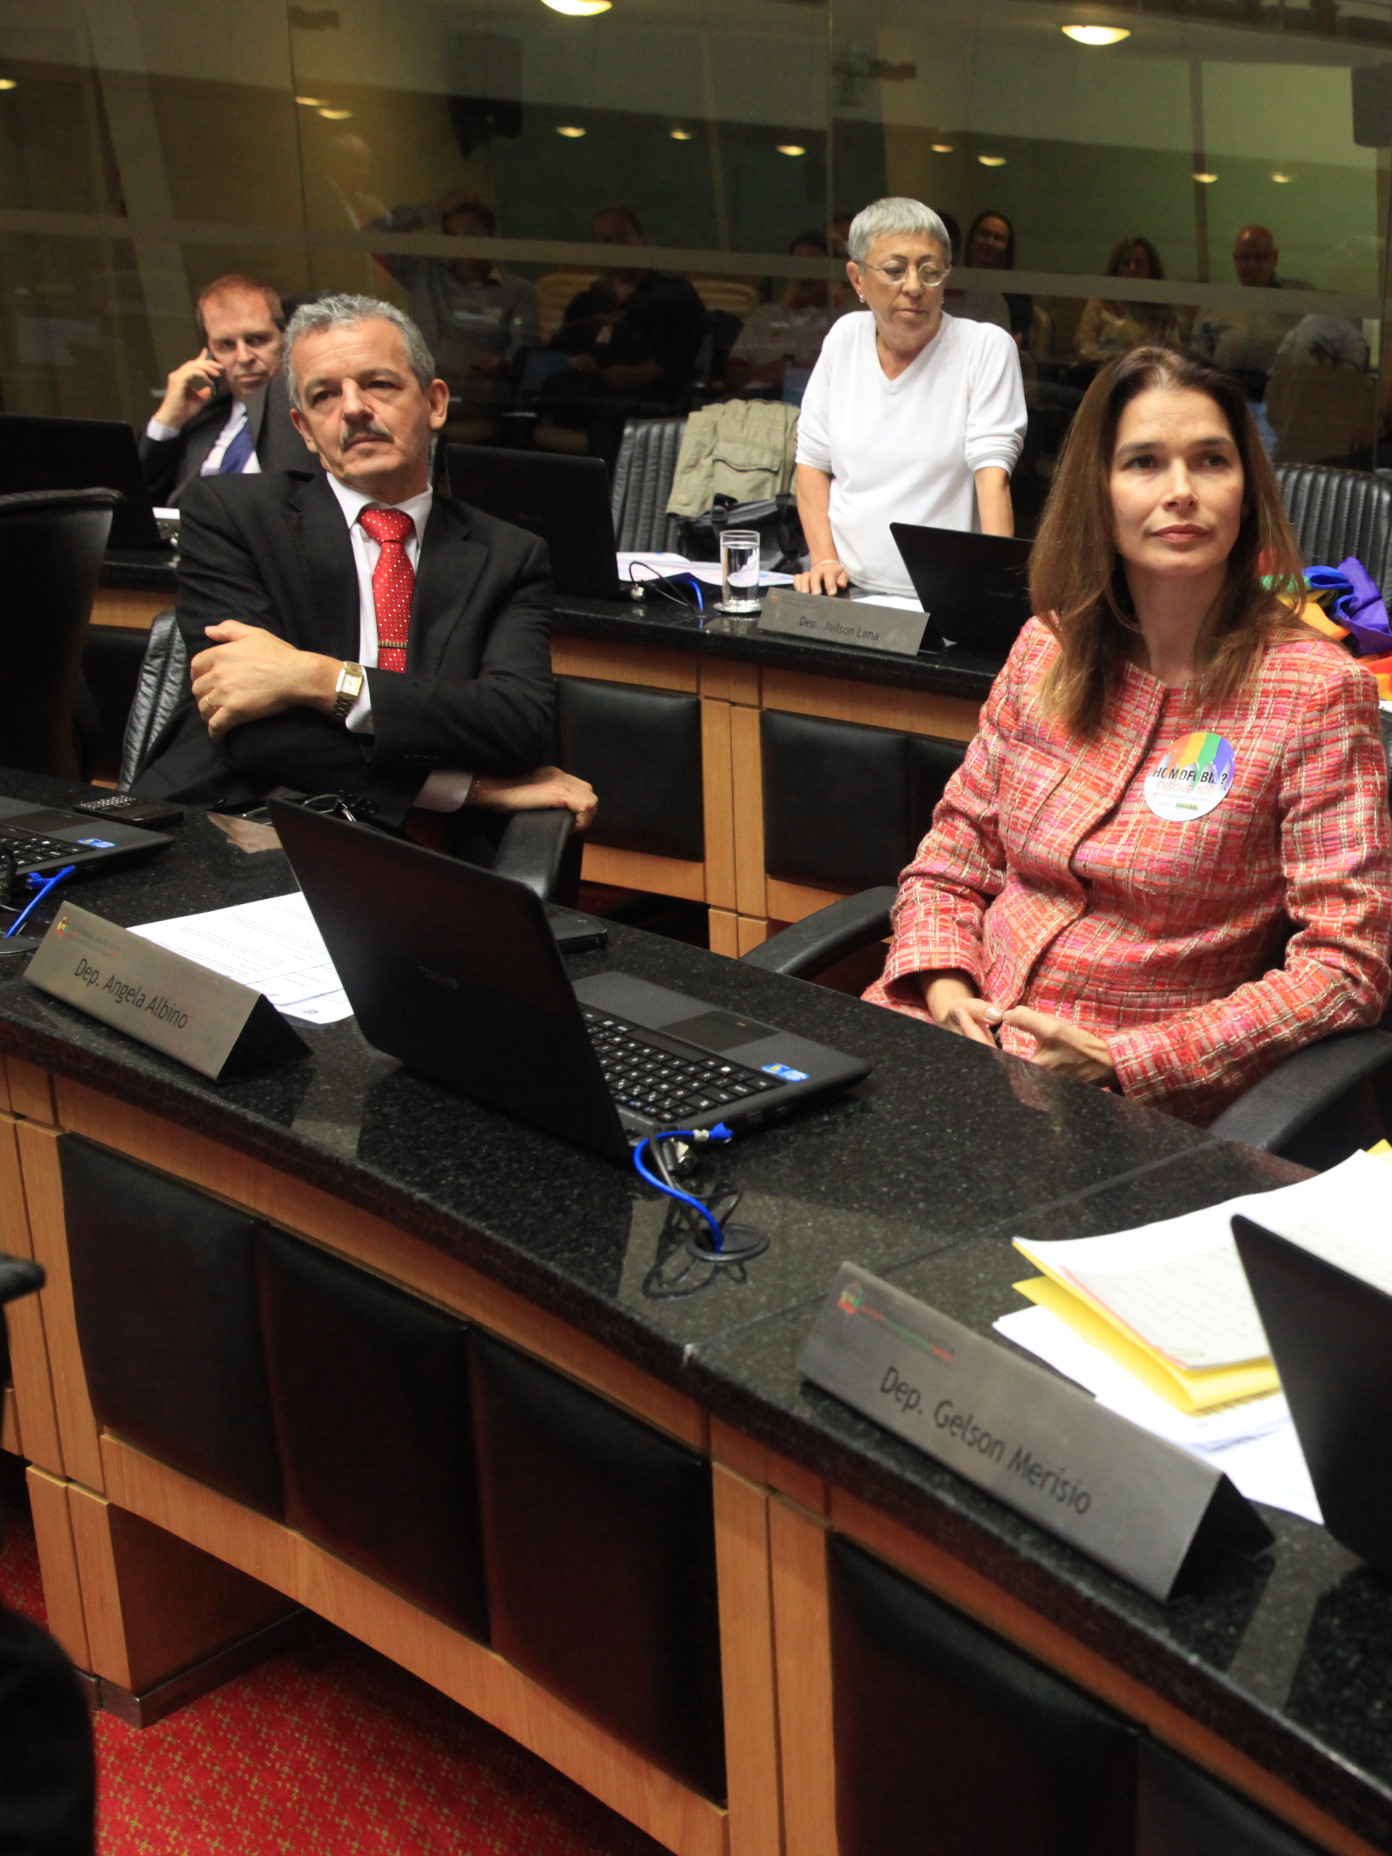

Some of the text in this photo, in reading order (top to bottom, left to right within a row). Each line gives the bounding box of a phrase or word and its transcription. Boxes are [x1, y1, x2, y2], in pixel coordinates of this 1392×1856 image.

[799, 616, 819, 631] Dep.
[857, 627, 880, 641] Lima
[1156, 781, 1215, 797] DISQUE 100
[74, 957, 189, 1030] Dep. Angela Albino
[880, 1366, 1093, 1516] Dep. Gelson Merisio
